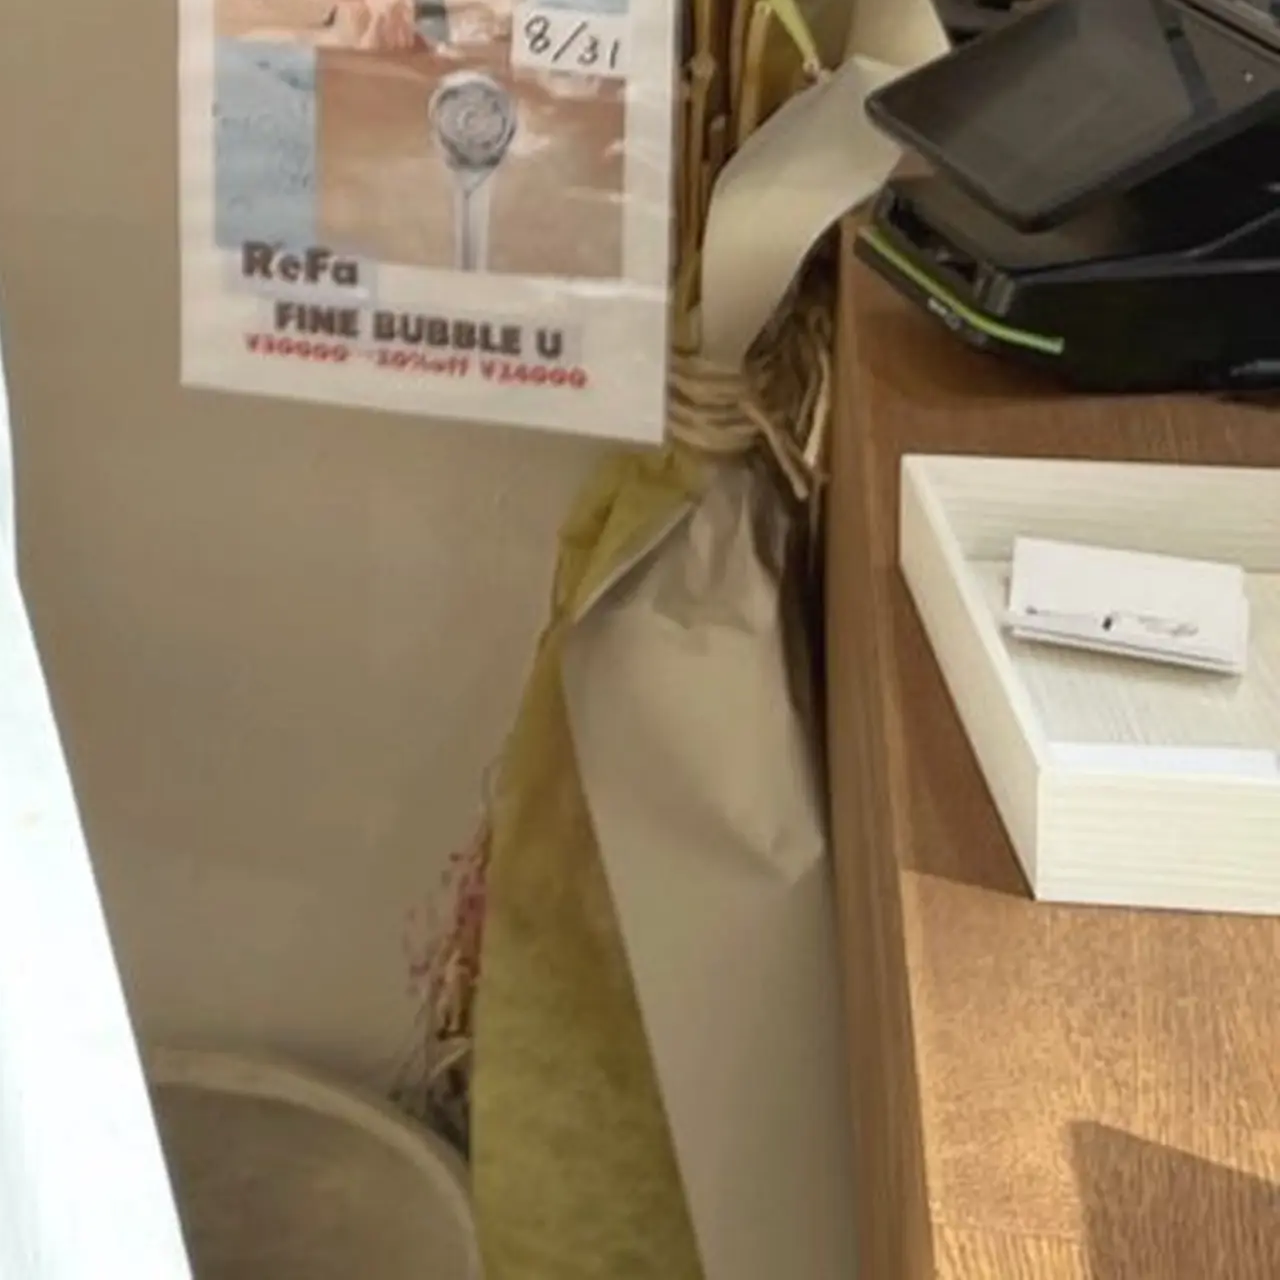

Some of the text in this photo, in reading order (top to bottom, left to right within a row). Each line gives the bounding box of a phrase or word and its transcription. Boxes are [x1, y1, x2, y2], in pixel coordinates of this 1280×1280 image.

[524, 15, 620, 69] 8/31
[241, 240, 358, 286] ReFa
[274, 301, 563, 358] FINE BUBBLE U
